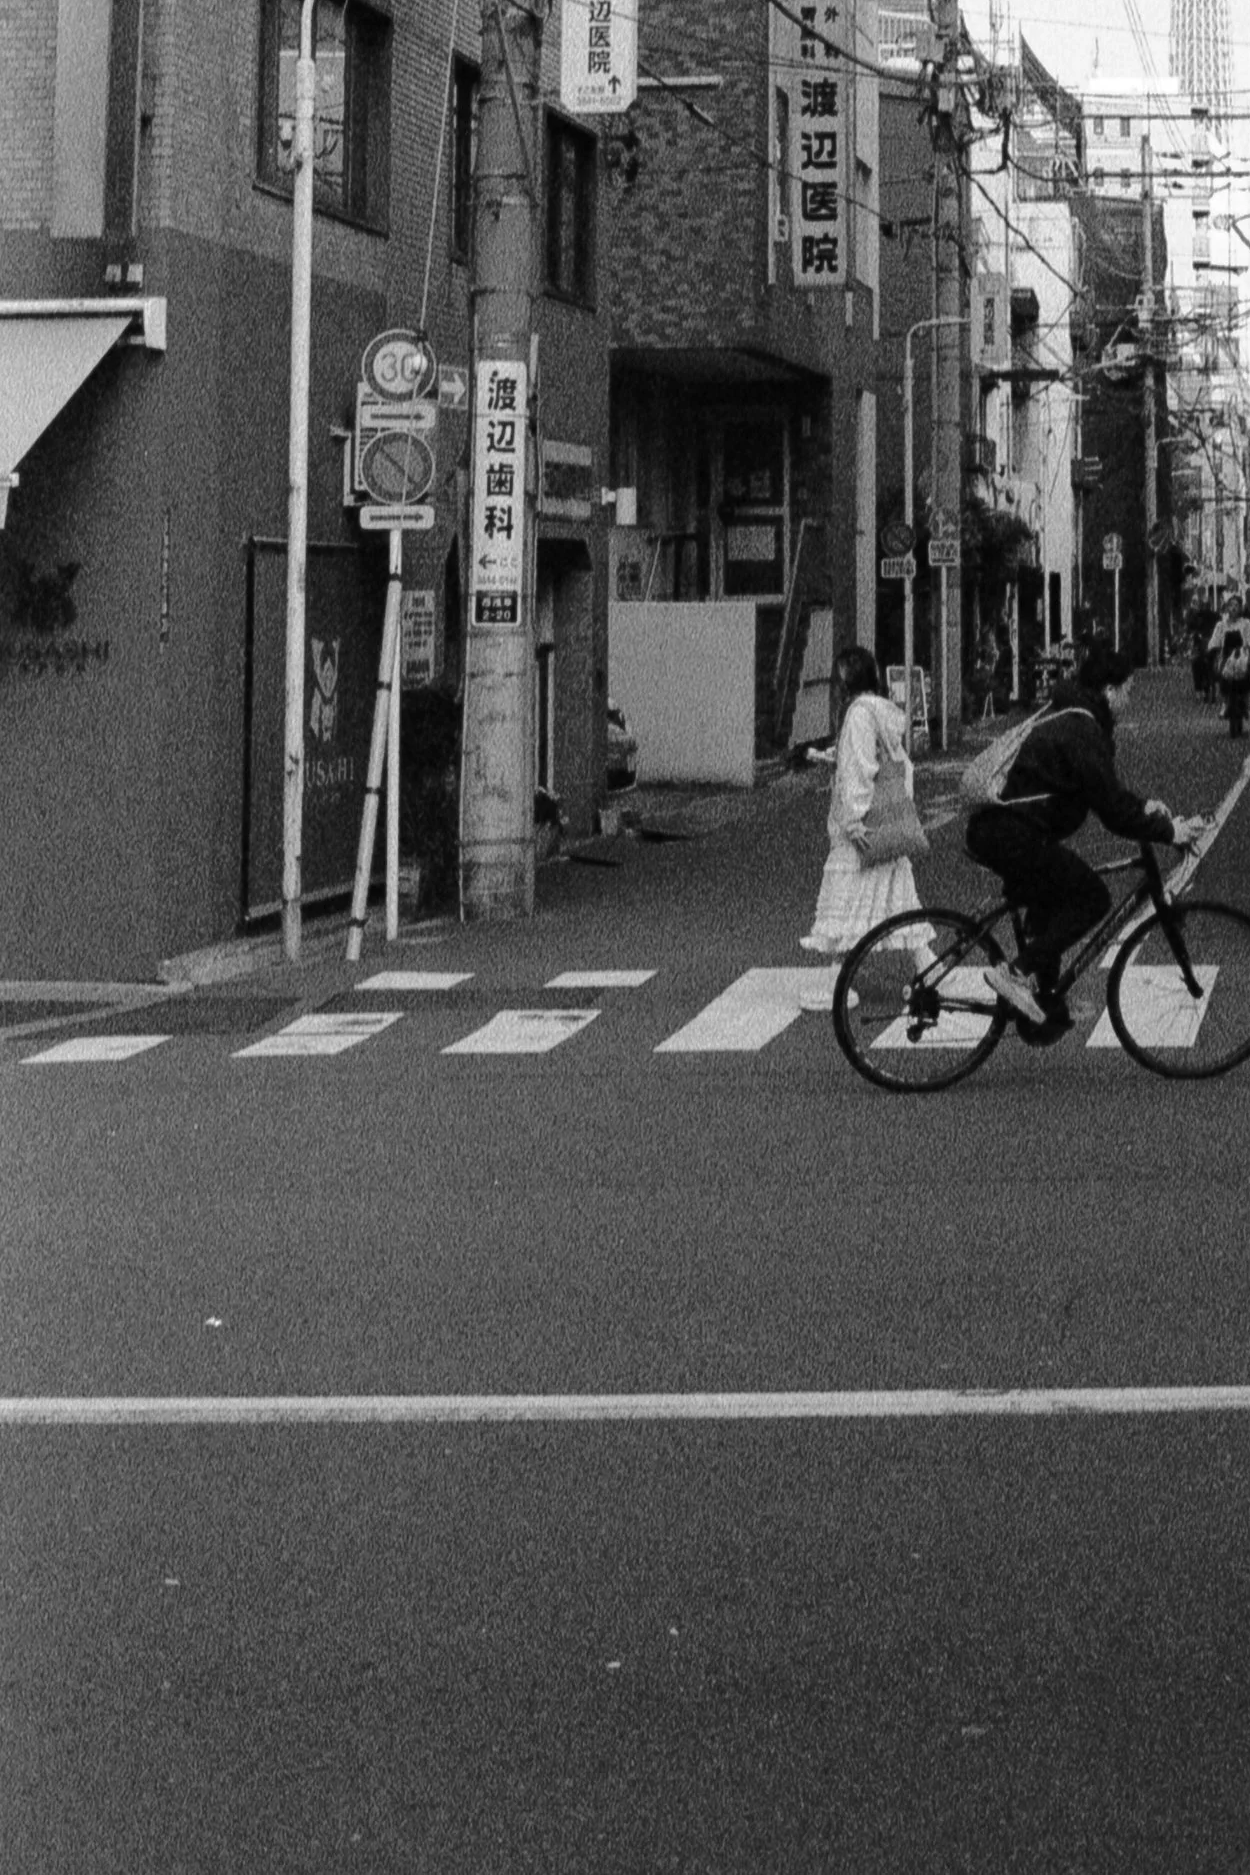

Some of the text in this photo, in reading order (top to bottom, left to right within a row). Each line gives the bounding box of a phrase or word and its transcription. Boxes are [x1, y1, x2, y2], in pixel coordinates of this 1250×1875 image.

[801, 76, 838, 274] 渡辺医院
[381, 353, 418, 382] 30
[485, 370, 517, 541] 渡辺歯科
